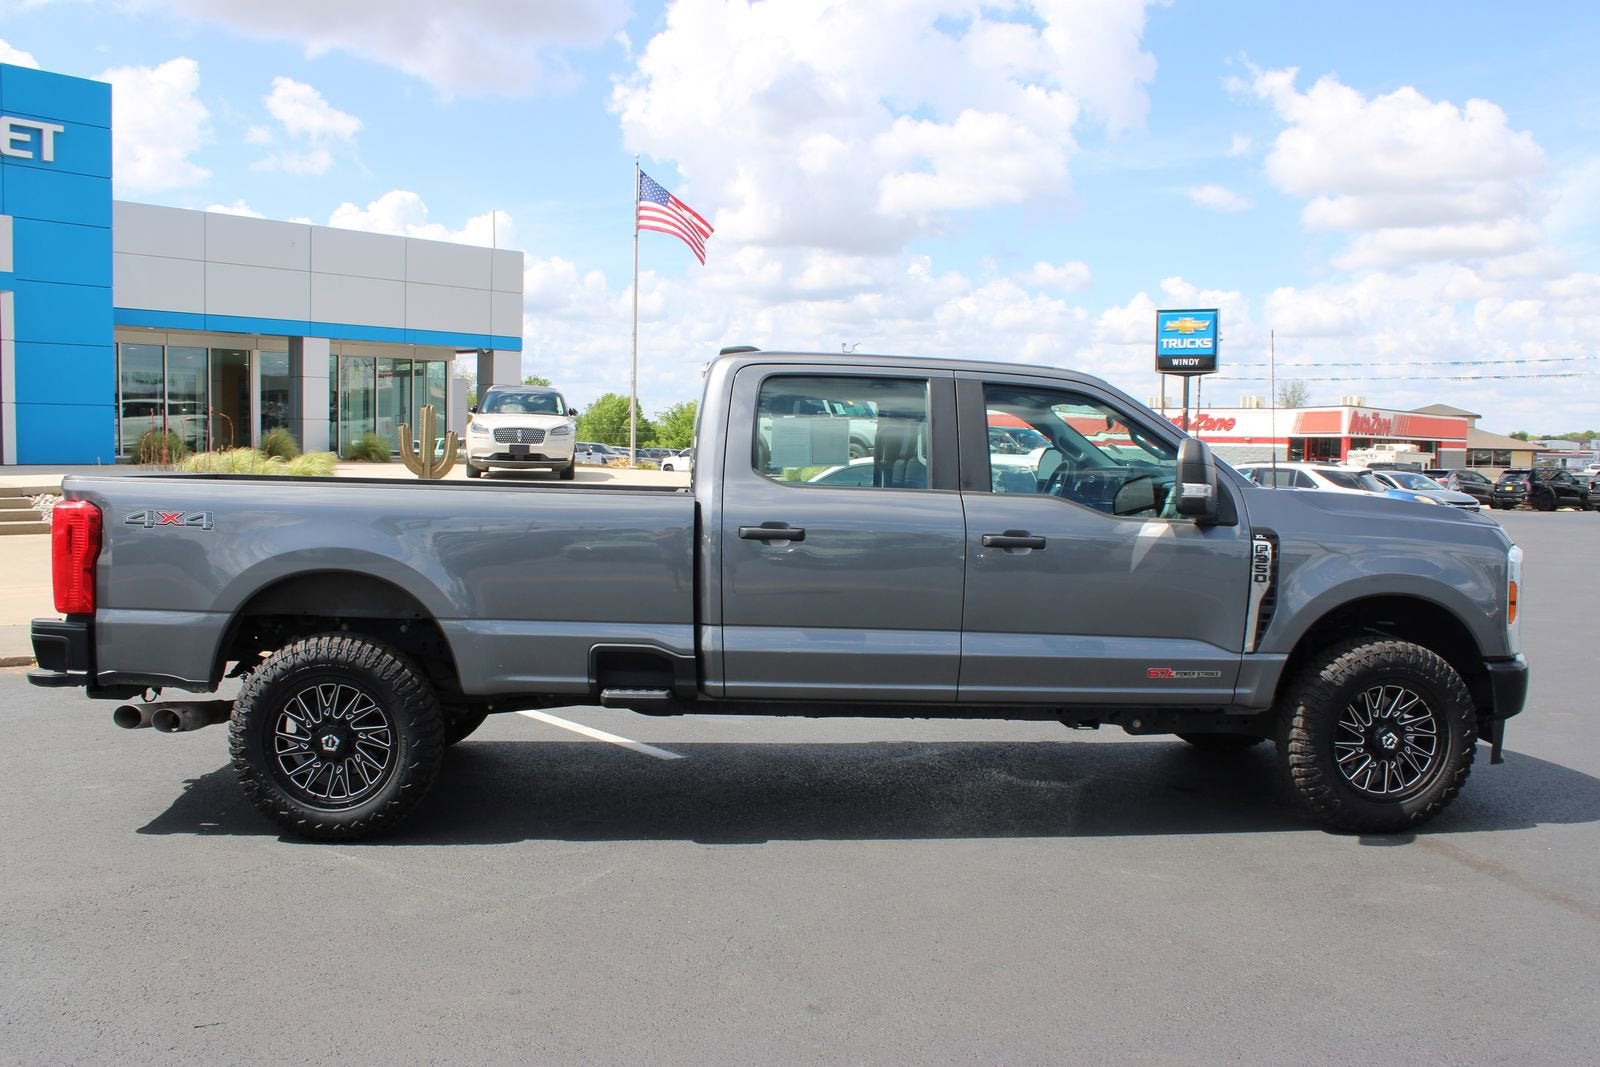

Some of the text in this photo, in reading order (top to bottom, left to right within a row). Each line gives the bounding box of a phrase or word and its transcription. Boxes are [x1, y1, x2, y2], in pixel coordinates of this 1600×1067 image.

[0, 116, 64, 161] ET
[1161, 338, 1212, 348] TRUCKS
[1349, 409, 1391, 435] AutoZone
